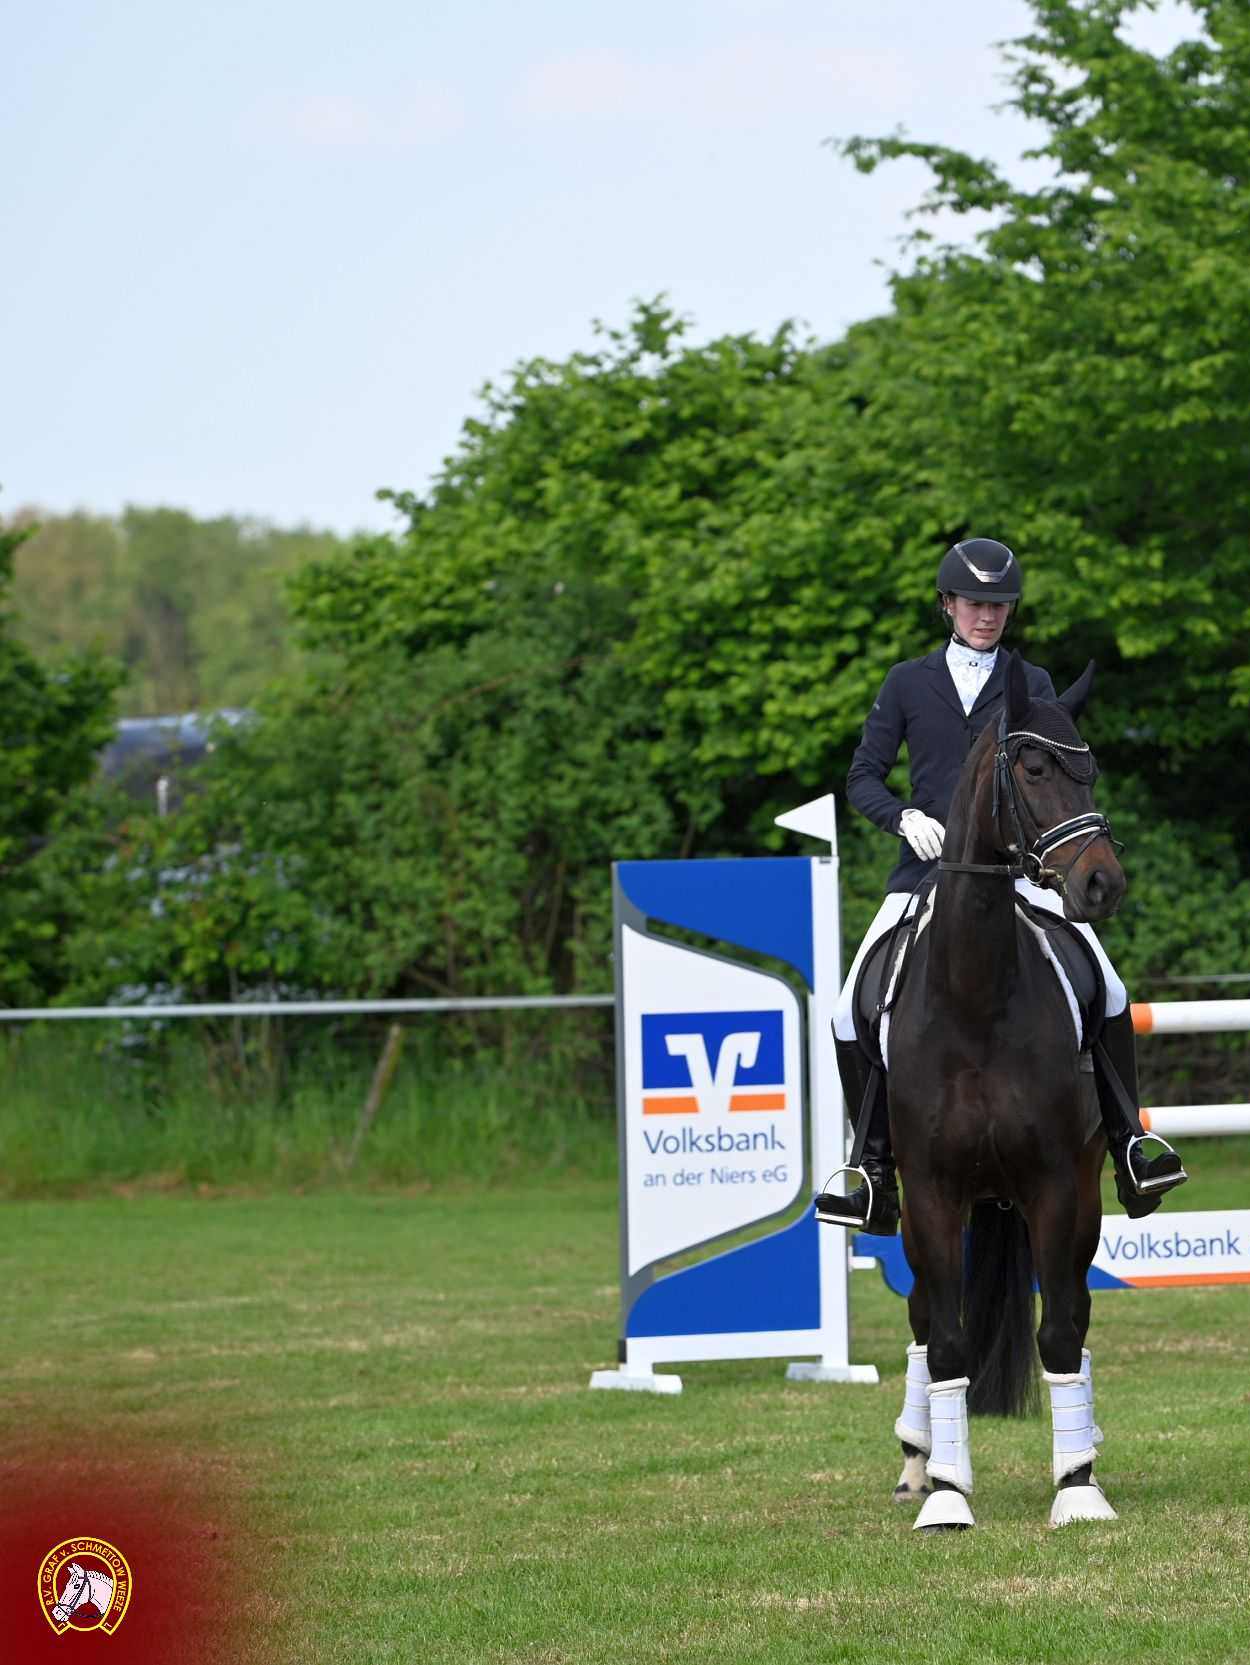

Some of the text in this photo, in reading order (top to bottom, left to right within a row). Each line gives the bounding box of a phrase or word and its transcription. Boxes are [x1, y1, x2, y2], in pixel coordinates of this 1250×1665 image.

[643, 1124, 785, 1154] Volksbank
[643, 1164, 787, 1187] an der Niers eG
[1103, 1230, 1241, 1261] Volksbank
